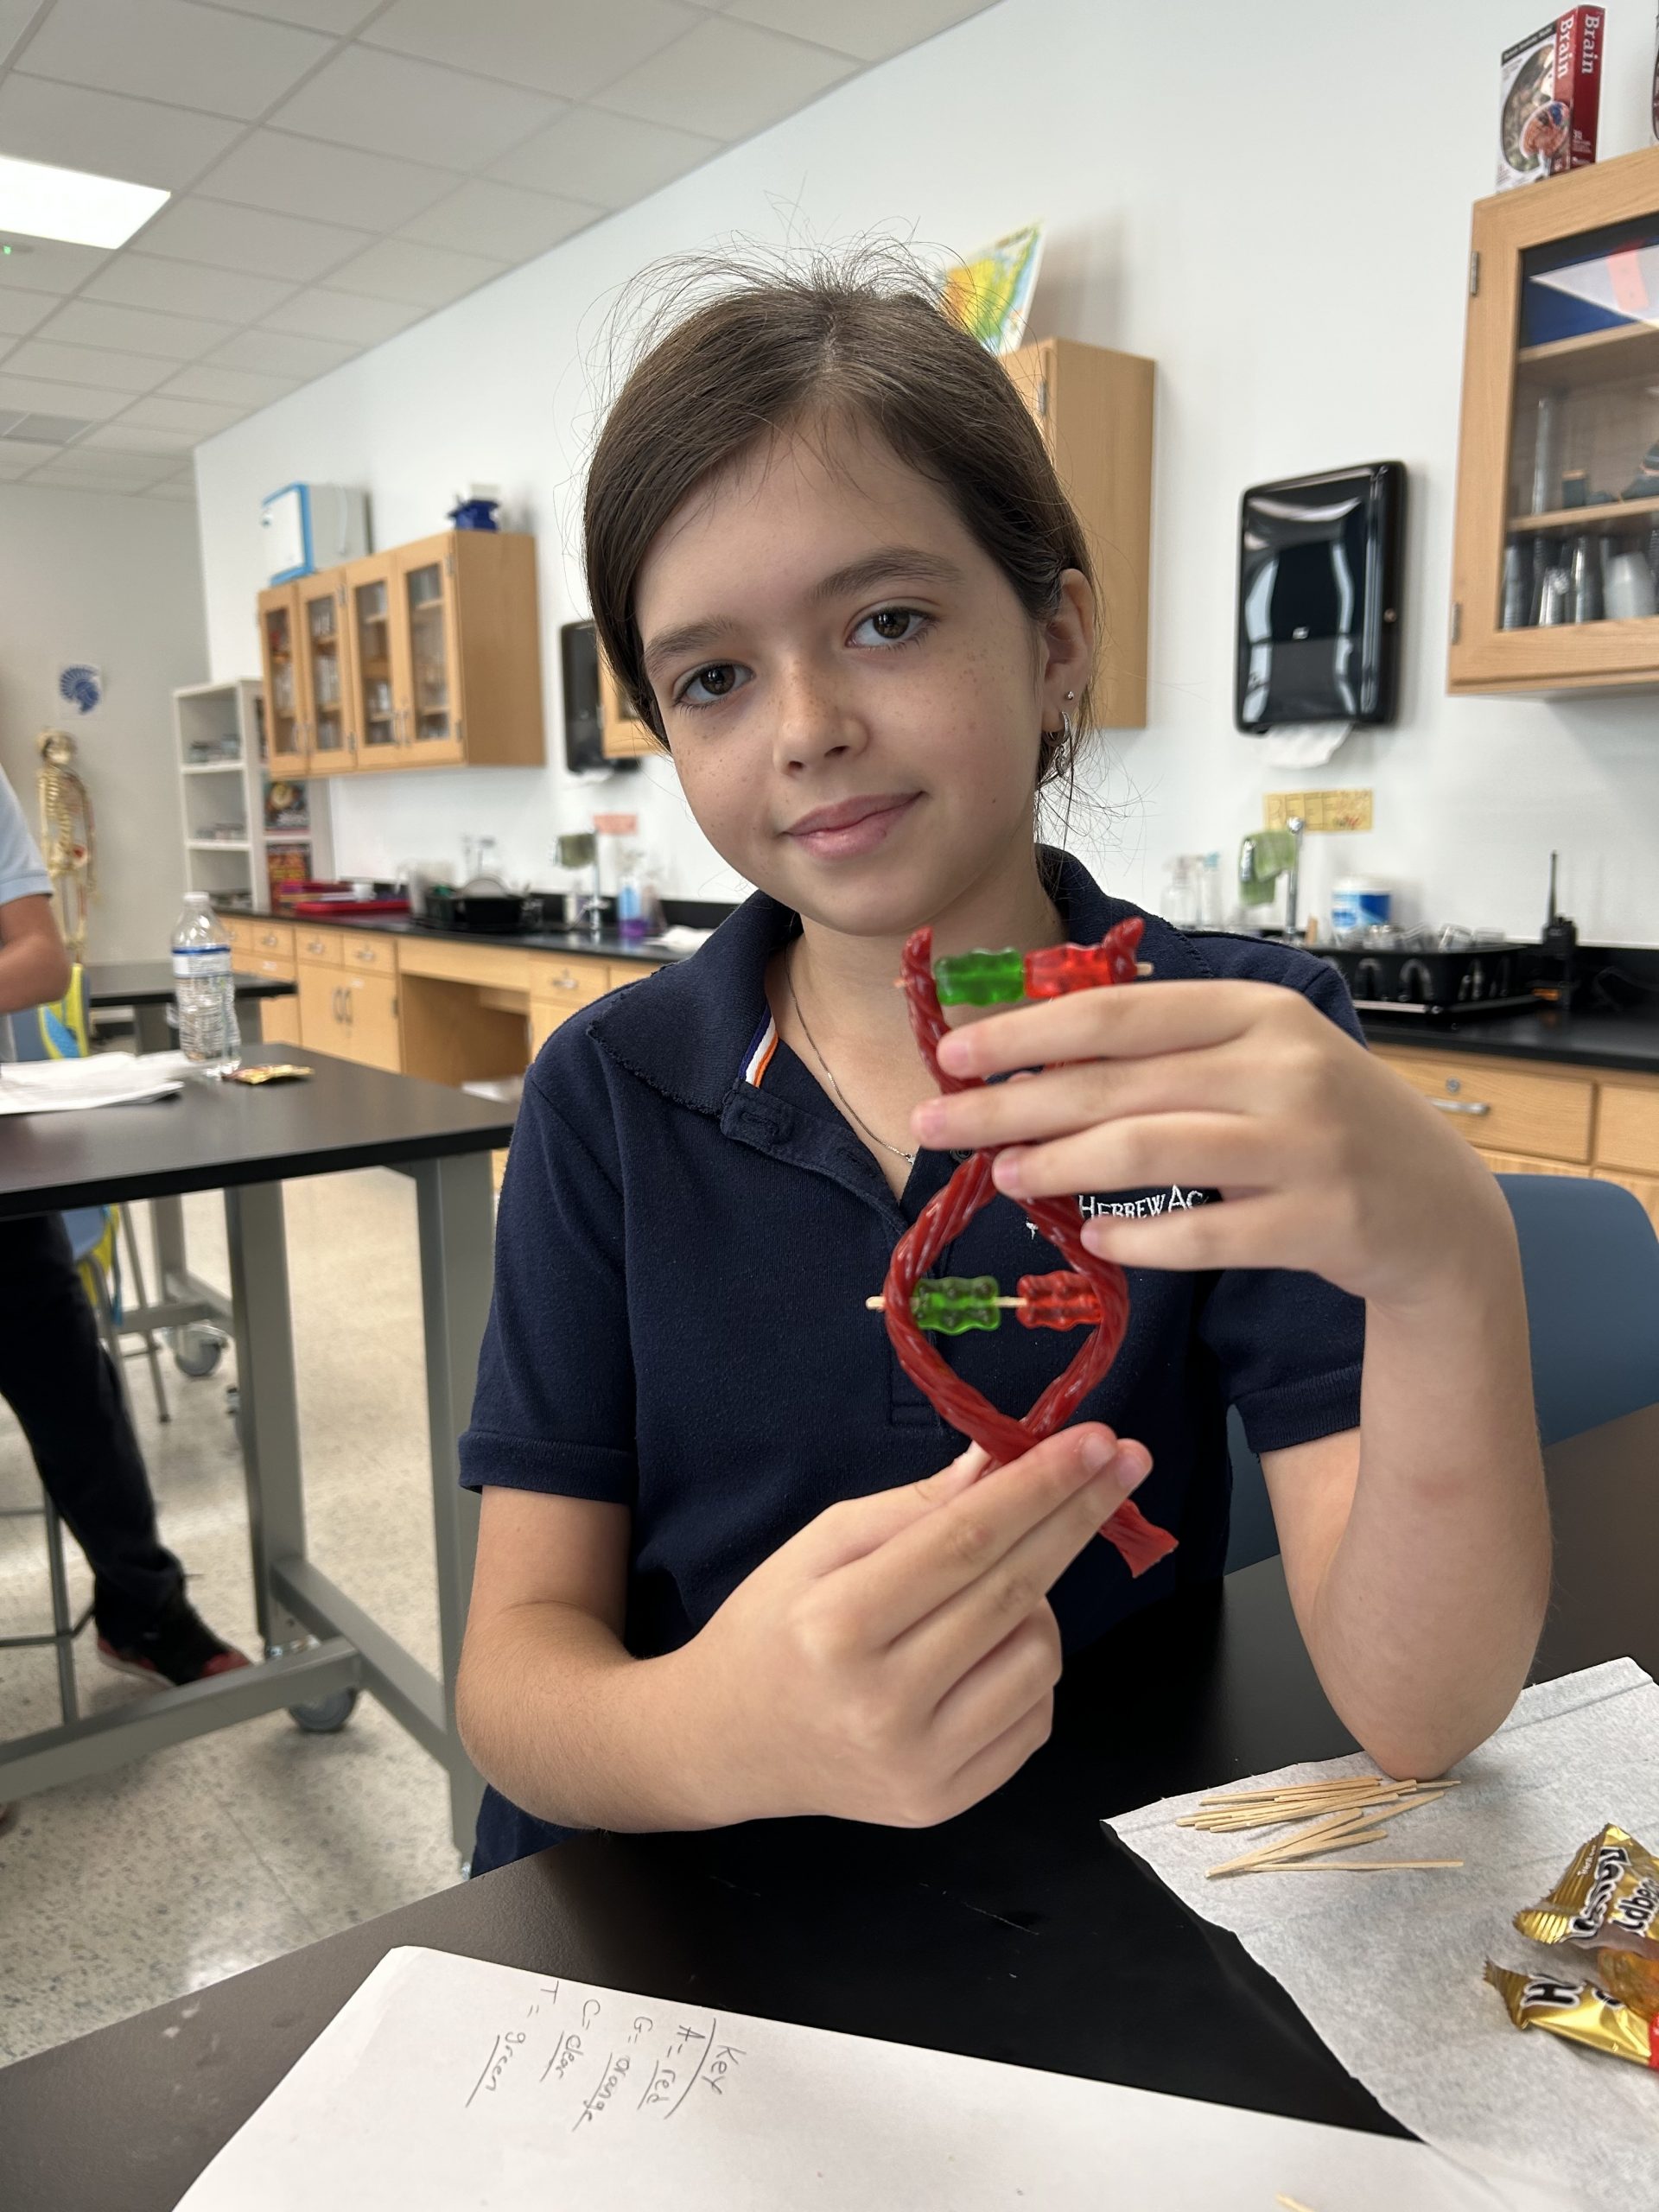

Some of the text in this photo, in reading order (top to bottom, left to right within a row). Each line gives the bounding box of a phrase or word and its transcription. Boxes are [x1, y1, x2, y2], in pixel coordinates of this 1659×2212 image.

[1558, 16, 1574, 78] Brain
[1582, 15, 1599, 73] Brain
[1078, 1184, 1205, 1219] HEBREW AC
[484, 2031, 526, 2092] green
[582, 2056, 630, 2122] orange
[702, 2045, 747, 2094] Key
